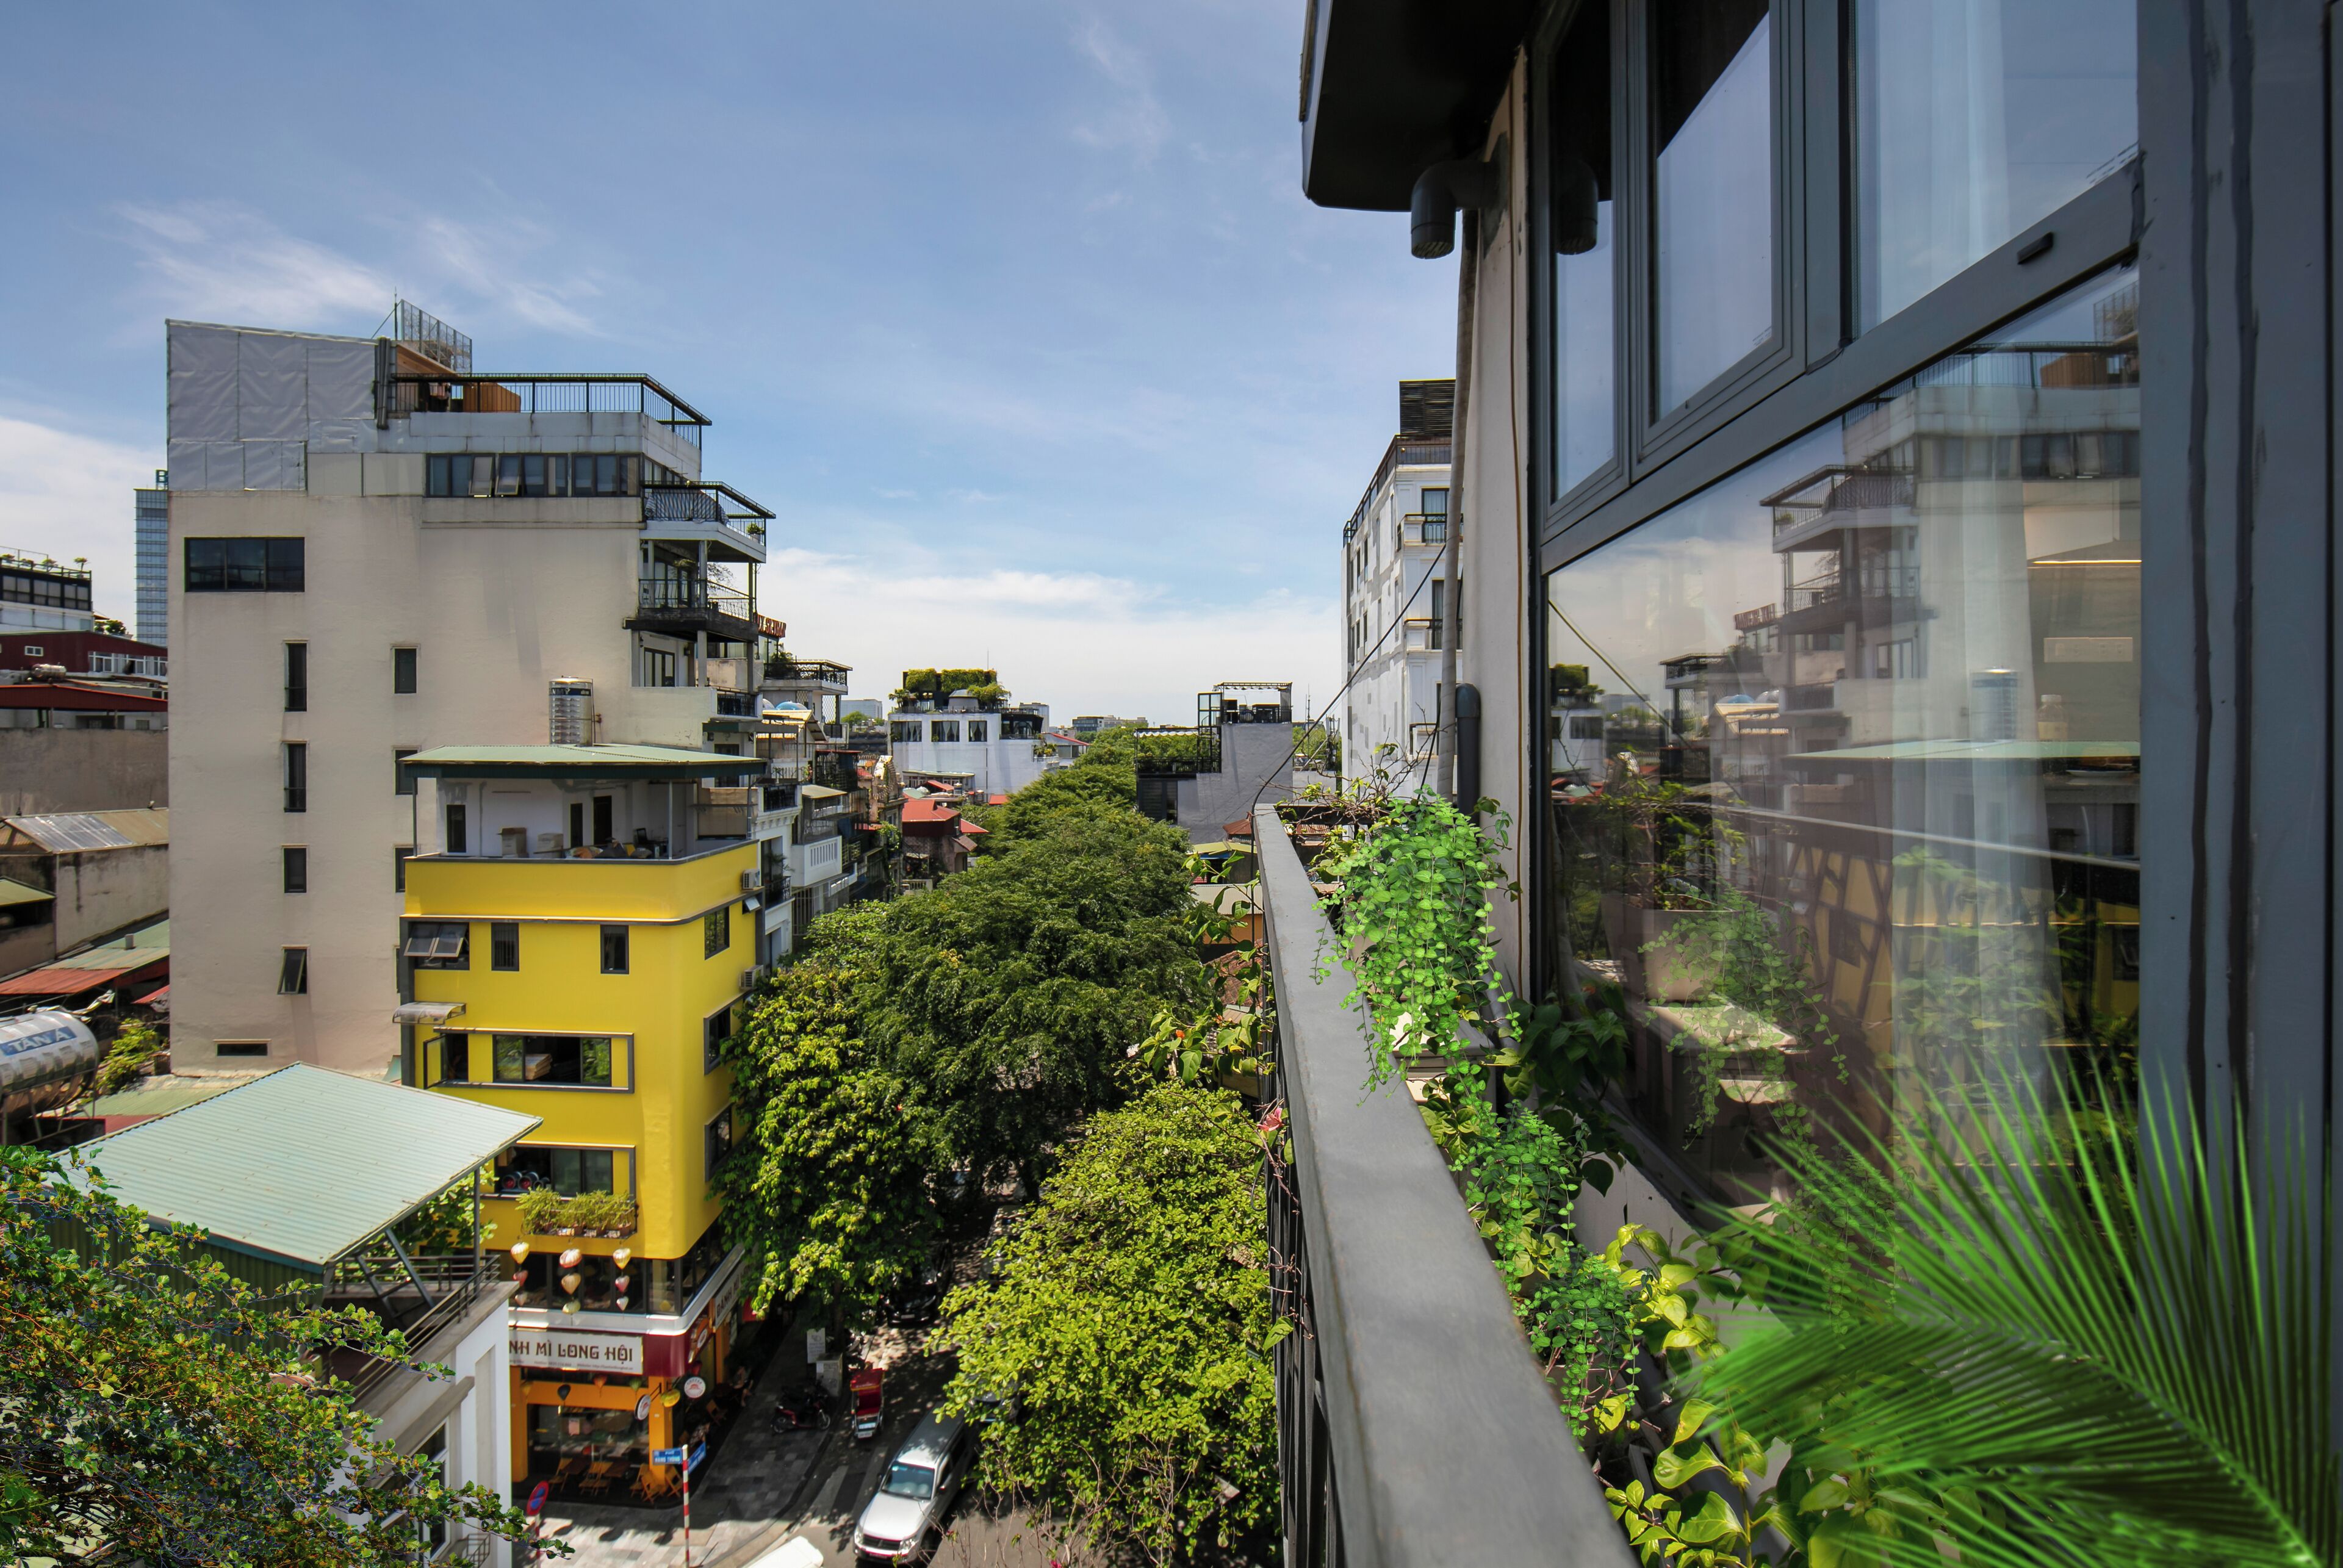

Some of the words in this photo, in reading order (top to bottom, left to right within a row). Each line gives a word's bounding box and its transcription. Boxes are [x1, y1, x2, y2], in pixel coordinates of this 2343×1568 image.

[509, 1341, 530, 1355] NH
[536, 1339, 552, 1356] MÌ
[558, 1343, 599, 1359] LONG
[604, 1344, 633, 1364] HỘI
